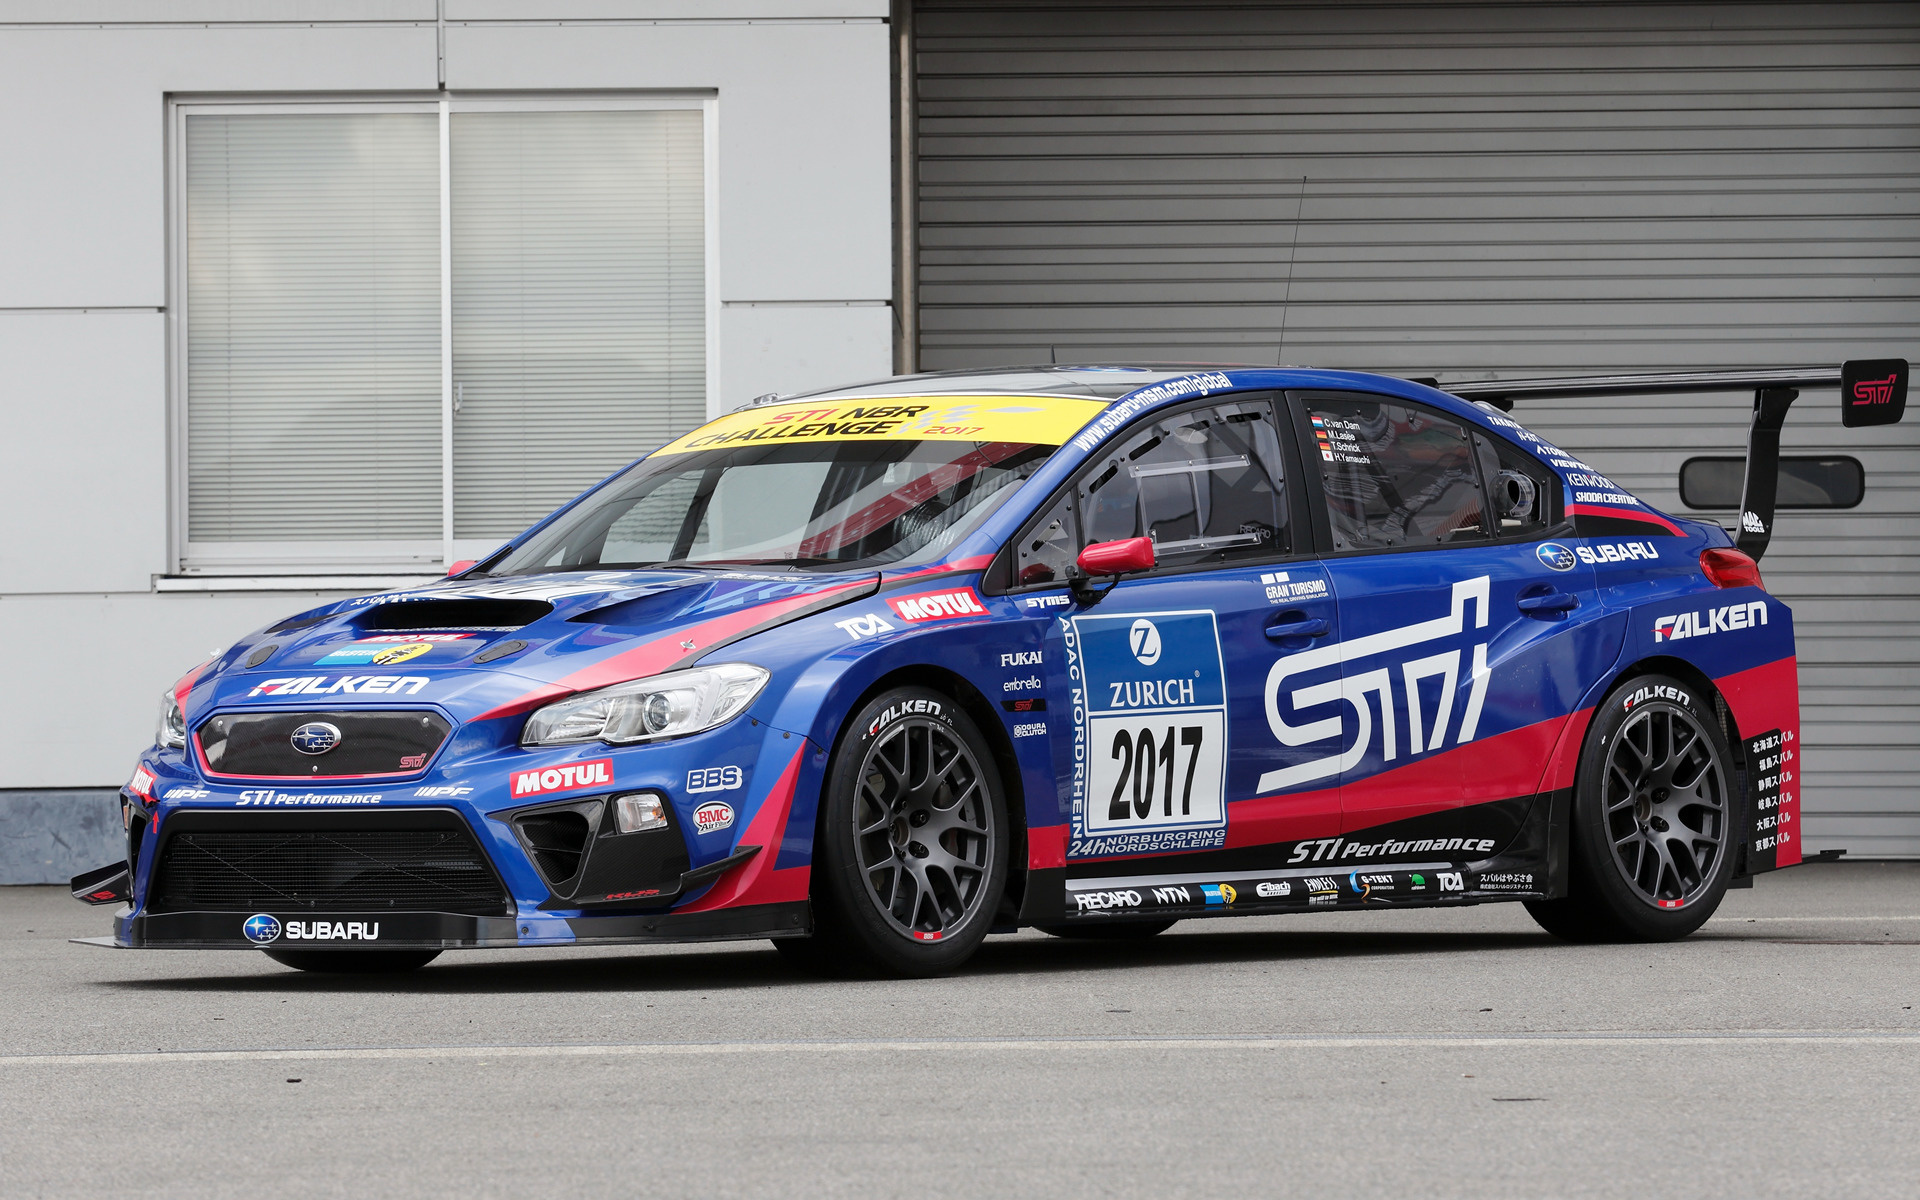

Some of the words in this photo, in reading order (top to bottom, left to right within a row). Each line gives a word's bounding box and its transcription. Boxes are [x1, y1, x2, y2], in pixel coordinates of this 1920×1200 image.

[763, 408, 839, 425] STI
[839, 405, 929, 420] NBR
[1073, 372, 1234, 452] www.subaru-msm.com/global
[685, 420, 904, 448] CHALLENGE
[923, 426, 985, 435] 2017
[1344, 420, 1361, 431] Dam
[1566, 472, 1615, 489] KENWOOD
[1575, 491, 1603, 503] SHODA
[1743, 511, 1763, 526] MAC
[1744, 525, 1765, 533] TOOLS
[1576, 541, 1659, 564] SUBARU
[1265, 584, 1290, 599] GRAN
[1288, 579, 1326, 596] TURISMO
[896, 591, 984, 621] MOTUL
[834, 613, 896, 641] TOA
[1652, 600, 1768, 643] FALKEN
[1000, 650, 1043, 667] FUKAI
[1058, 616, 1080, 681] ADAC
[247, 676, 431, 697] FALKEN
[1003, 675, 1042, 692] embrella
[1109, 678, 1196, 708] ZURICH
[1623, 685, 1690, 712] FALKEN
[868, 699, 942, 736] FALKEN
[1021, 722, 1046, 731] OGURA
[1021, 728, 1047, 737] CLUTCH
[1753, 730, 1794, 754] 北海道スバル
[1070, 688, 1085, 839] NORDRHEIN
[1759, 749, 1793, 772] 福島スバル
[130, 768, 154, 795] MOTUL
[514, 762, 611, 795] MOTUL
[686, 764, 743, 794] BBS
[1108, 726, 1203, 821] 2017
[1757, 770, 1793, 792] 静岡スバル
[235, 790, 274, 806] STI
[274, 793, 382, 805] Performance
[1757, 791, 1793, 811] 岐阜スバル
[698, 808, 729, 823] BMC
[1756, 811, 1791, 831] 大阪スバル
[700, 822, 715, 831] Air
[1067, 840, 1106, 857] 24h
[1104, 838, 1225, 855] NORDSCHLEIFE
[1107, 829, 1226, 847] NÜRBURGRING
[1755, 831, 1791, 852] 京都スバル
[1287, 838, 1345, 864] STI
[1340, 838, 1496, 859] Performance
[1260, 881, 1291, 891] Eibach
[1304, 876, 1338, 893] ENDLESS
[1361, 874, 1394, 884] G-TEKT
[1436, 872, 1465, 892] TOA
[1074, 890, 1143, 911] RECARO
[1151, 886, 1191, 905] NTN
[285, 921, 379, 940] SUBARU
